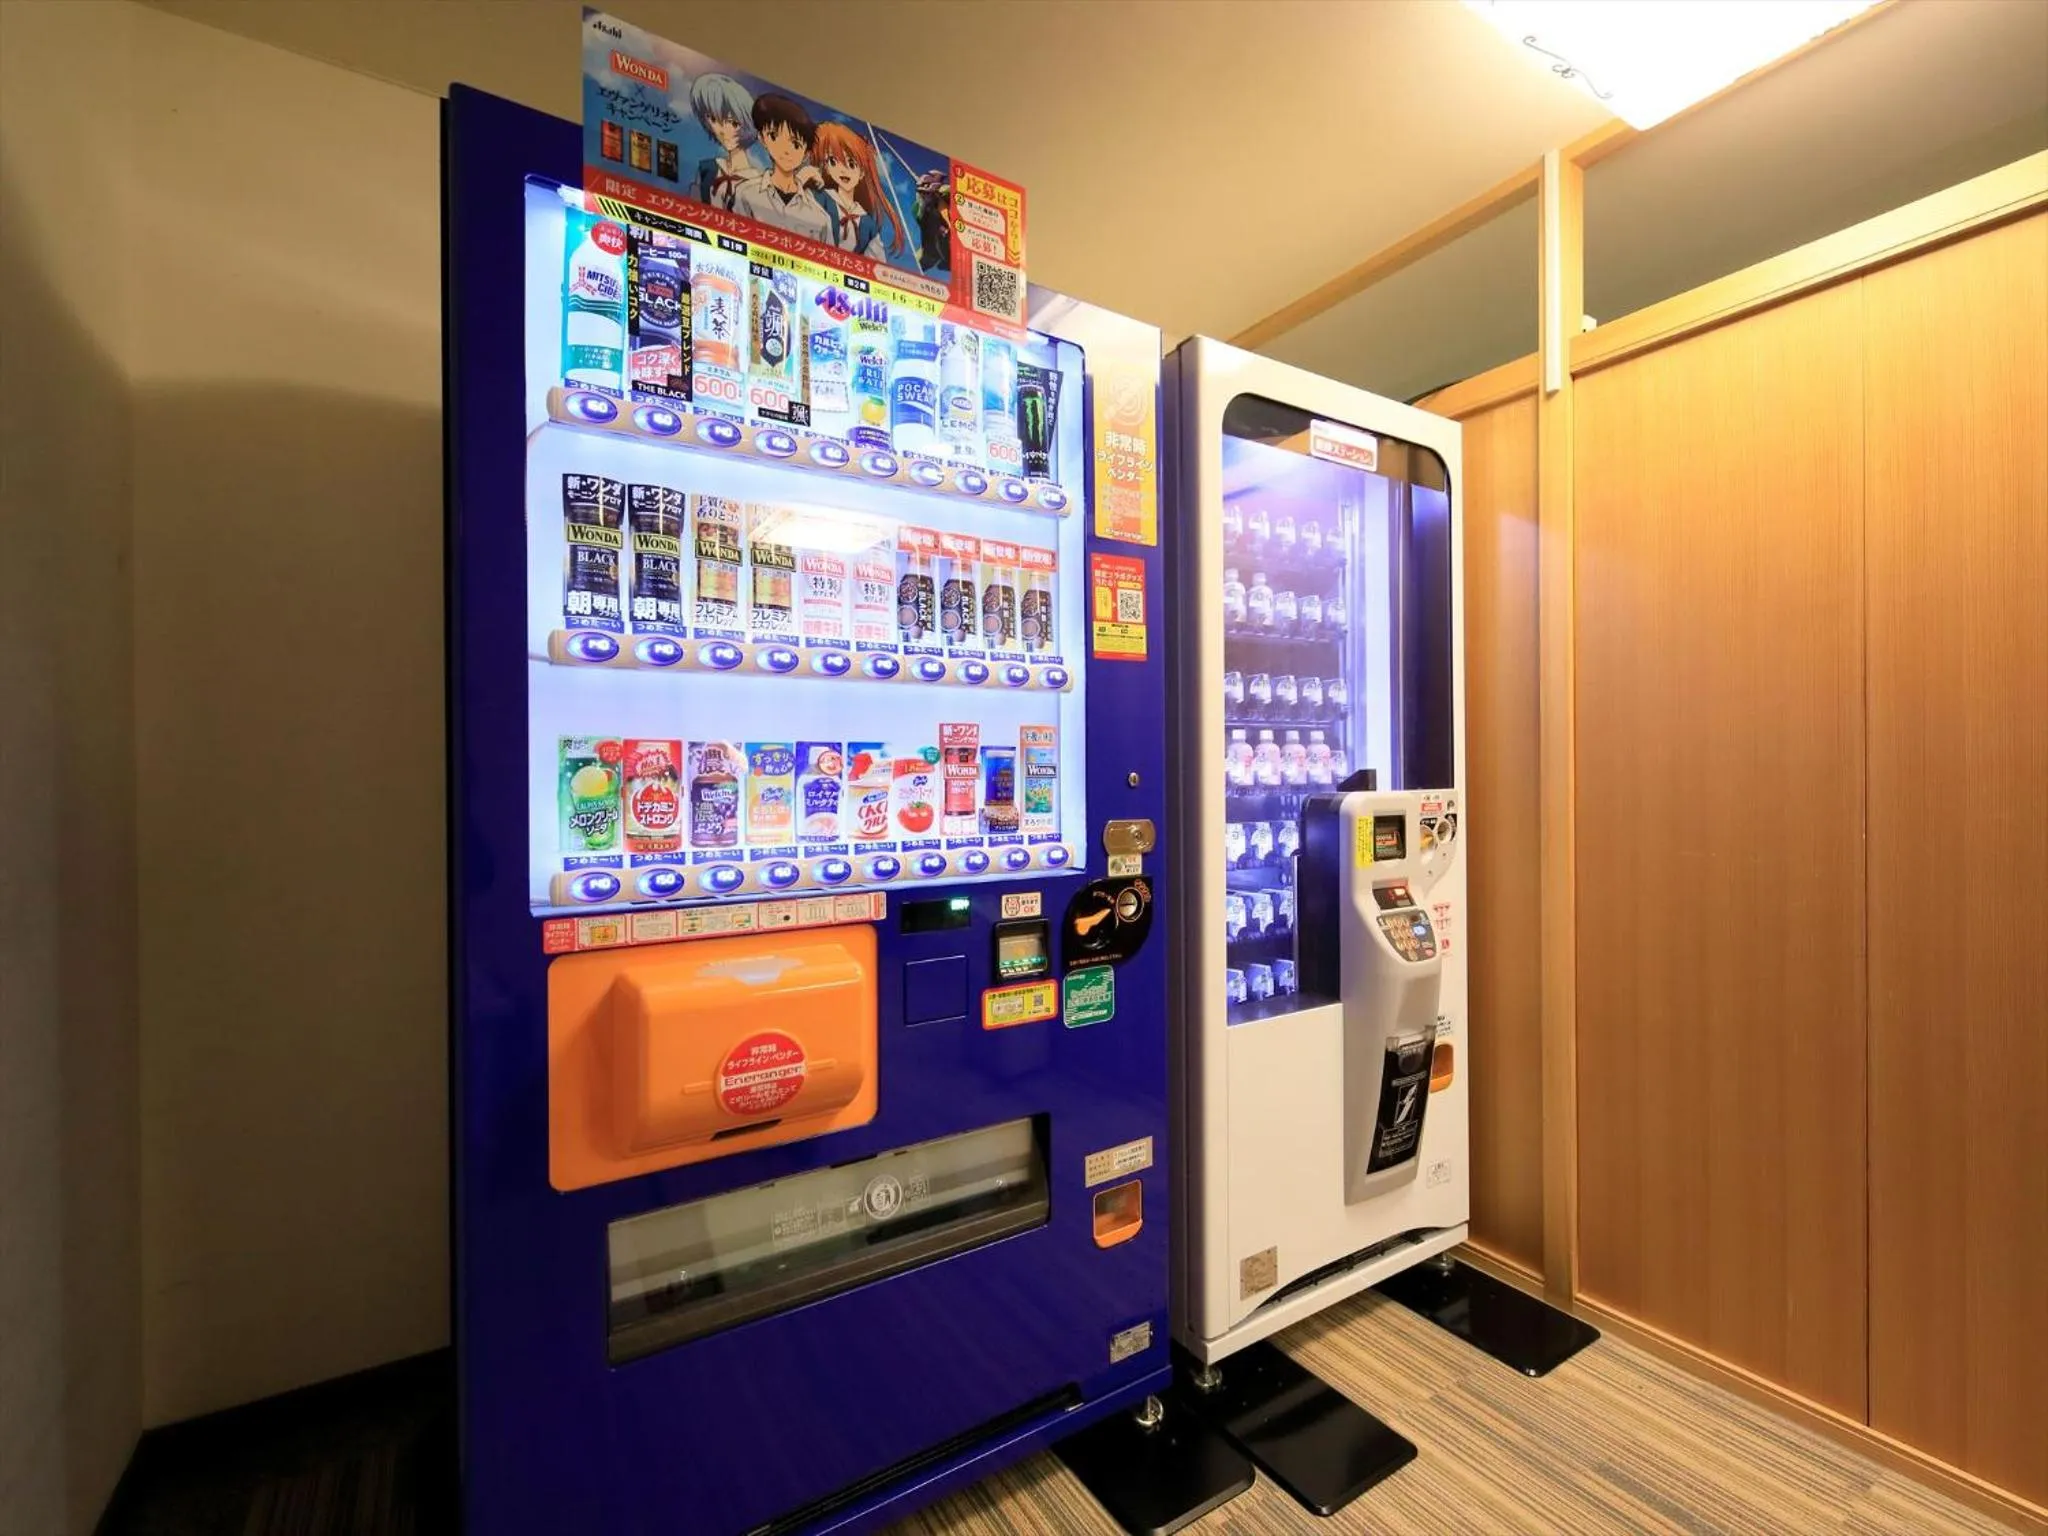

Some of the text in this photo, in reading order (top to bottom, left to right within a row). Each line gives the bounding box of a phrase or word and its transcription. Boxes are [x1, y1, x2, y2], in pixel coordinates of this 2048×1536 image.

[593, 20, 622, 39] Asahi
[615, 53, 664, 85] WONDA
[605, 178, 637, 200] 限定
[646, 193, 750, 234] エヴァンゲリオン
[815, 286, 888, 323] Asahi
[710, 297, 731, 341] 麦茶
[638, 382, 687, 400] THE BLACK
[694, 374, 738, 400] 600
[572, 525, 619, 546] WONDA
[637, 534, 678, 553] WONDA
[577, 551, 616, 566] BLACK
[700, 544, 739, 562] WONDA
[754, 549, 793, 567] WONDA
[642, 559, 678, 573] BLACK
[806, 558, 843, 574] WONDA
[857, 563, 893, 581] WONDA
[947, 764, 978, 777] WONDA
[1028, 763, 1055, 776] WONDA
[724, 1066, 802, 1087] Eneranger
